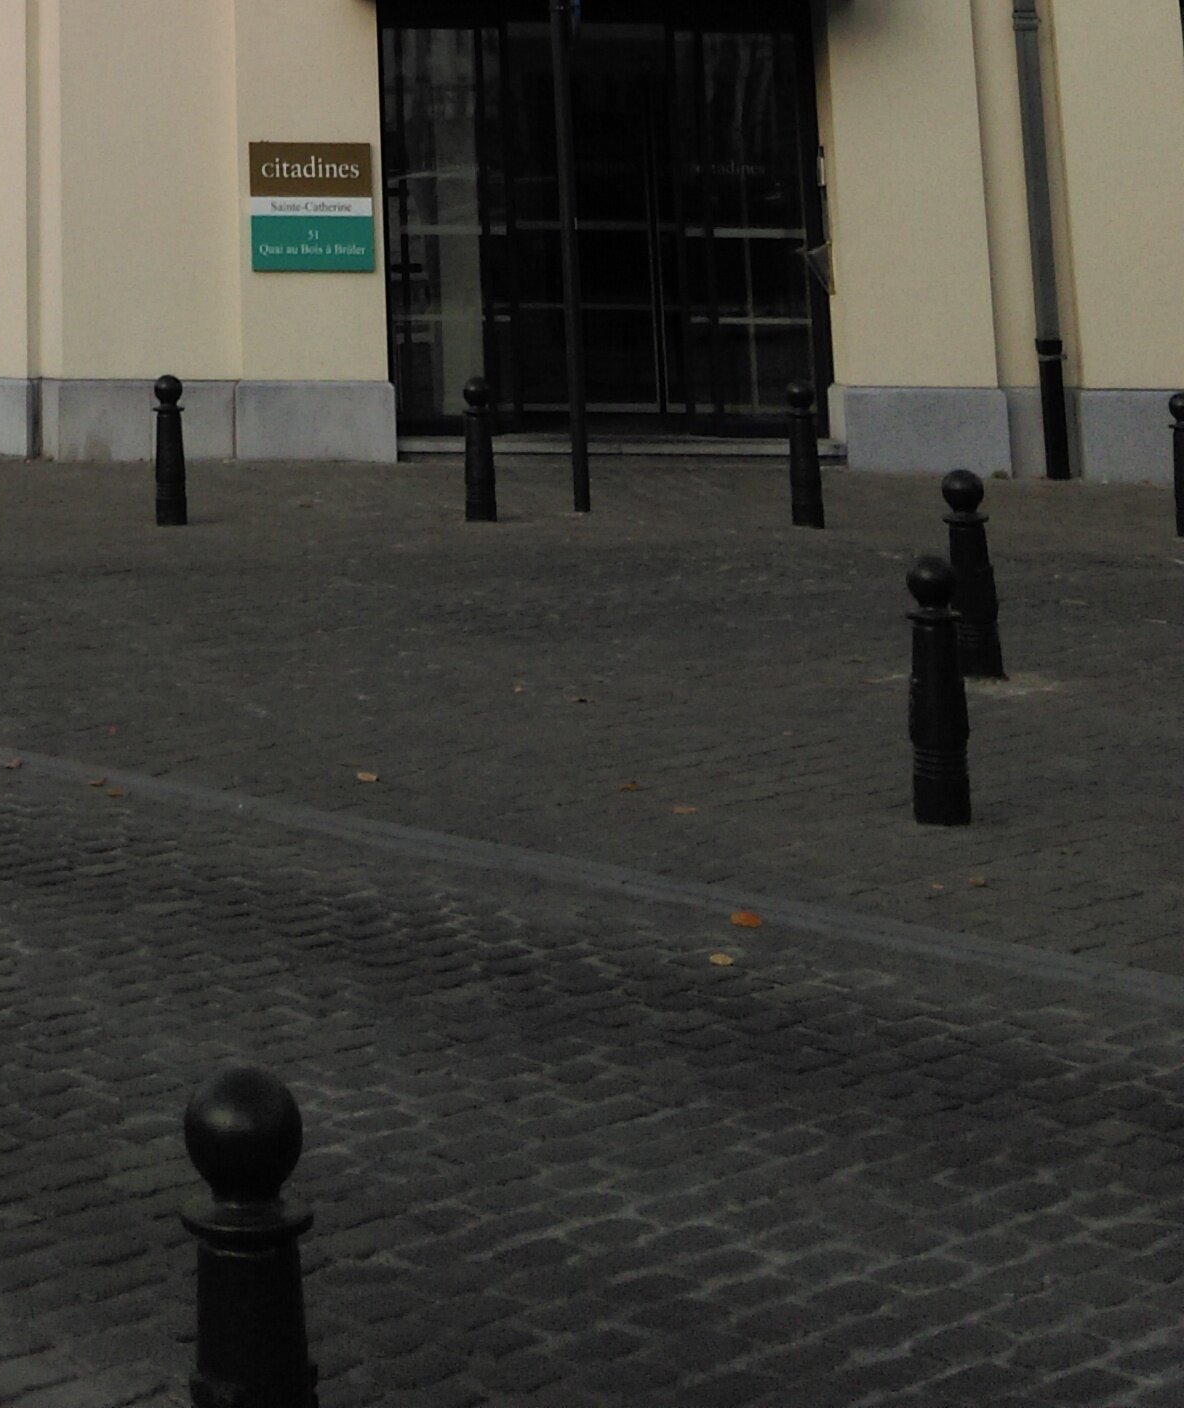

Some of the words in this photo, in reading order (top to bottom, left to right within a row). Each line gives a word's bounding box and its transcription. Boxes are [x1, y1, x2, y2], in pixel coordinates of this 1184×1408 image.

[261, 155, 360, 179] citadines
[307, 229, 319, 240] 51
[259, 244, 284, 256] Quai
[301, 244, 324, 255] Bois
